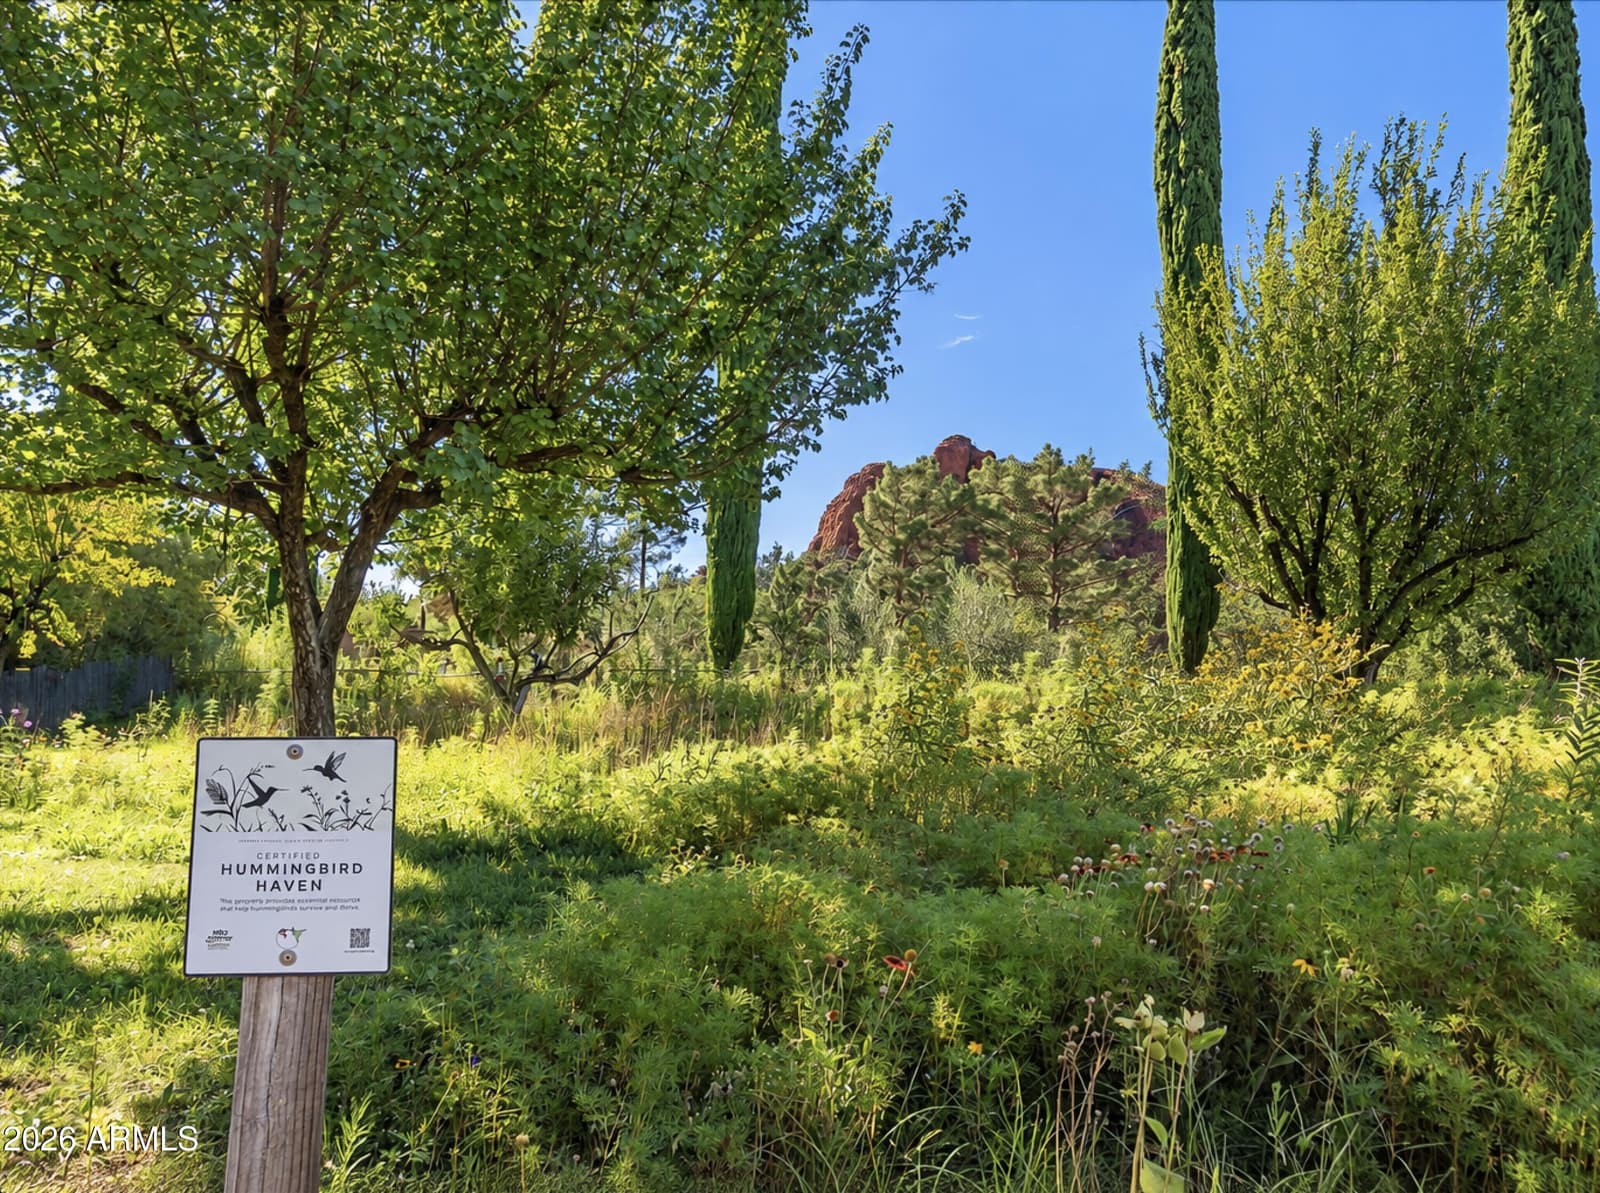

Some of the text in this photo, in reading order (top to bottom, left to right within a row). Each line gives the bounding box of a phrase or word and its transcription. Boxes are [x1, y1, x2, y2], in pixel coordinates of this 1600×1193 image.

[256, 852, 320, 860] CERTIFIED
[221, 863, 363, 875] HUMMINGBIRD
[256, 879, 322, 892] HAVEN
